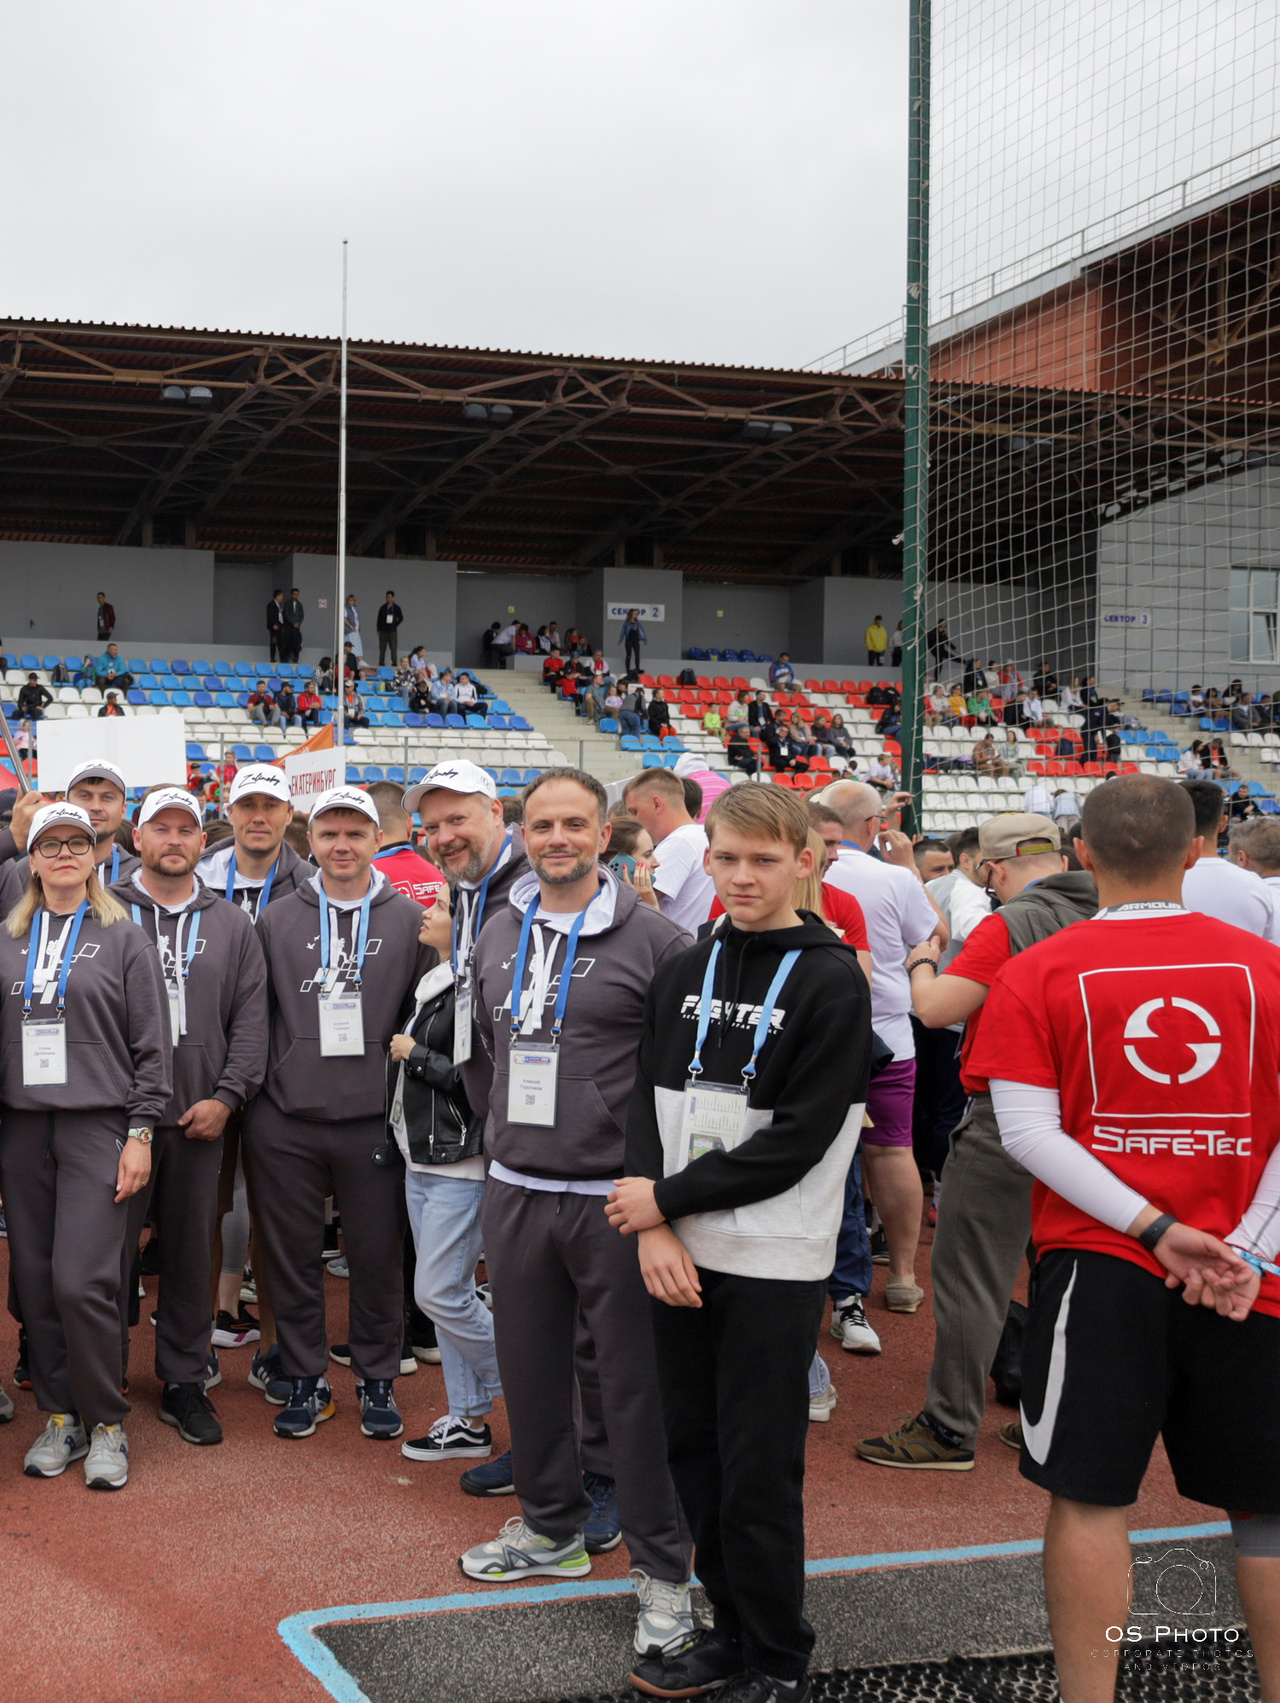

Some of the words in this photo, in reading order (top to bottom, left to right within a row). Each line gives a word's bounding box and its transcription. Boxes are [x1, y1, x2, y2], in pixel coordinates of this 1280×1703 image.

[611, 607, 646, 617] СЕКОР
[653, 608, 659, 617] 2
[1104, 614, 1136, 623] СЕКТОР
[291, 769, 336, 797] ЕКАТЕРИНБУРГ
[413, 881, 443, 895] SAFE
[1117, 901, 1182, 911] ARMOUR
